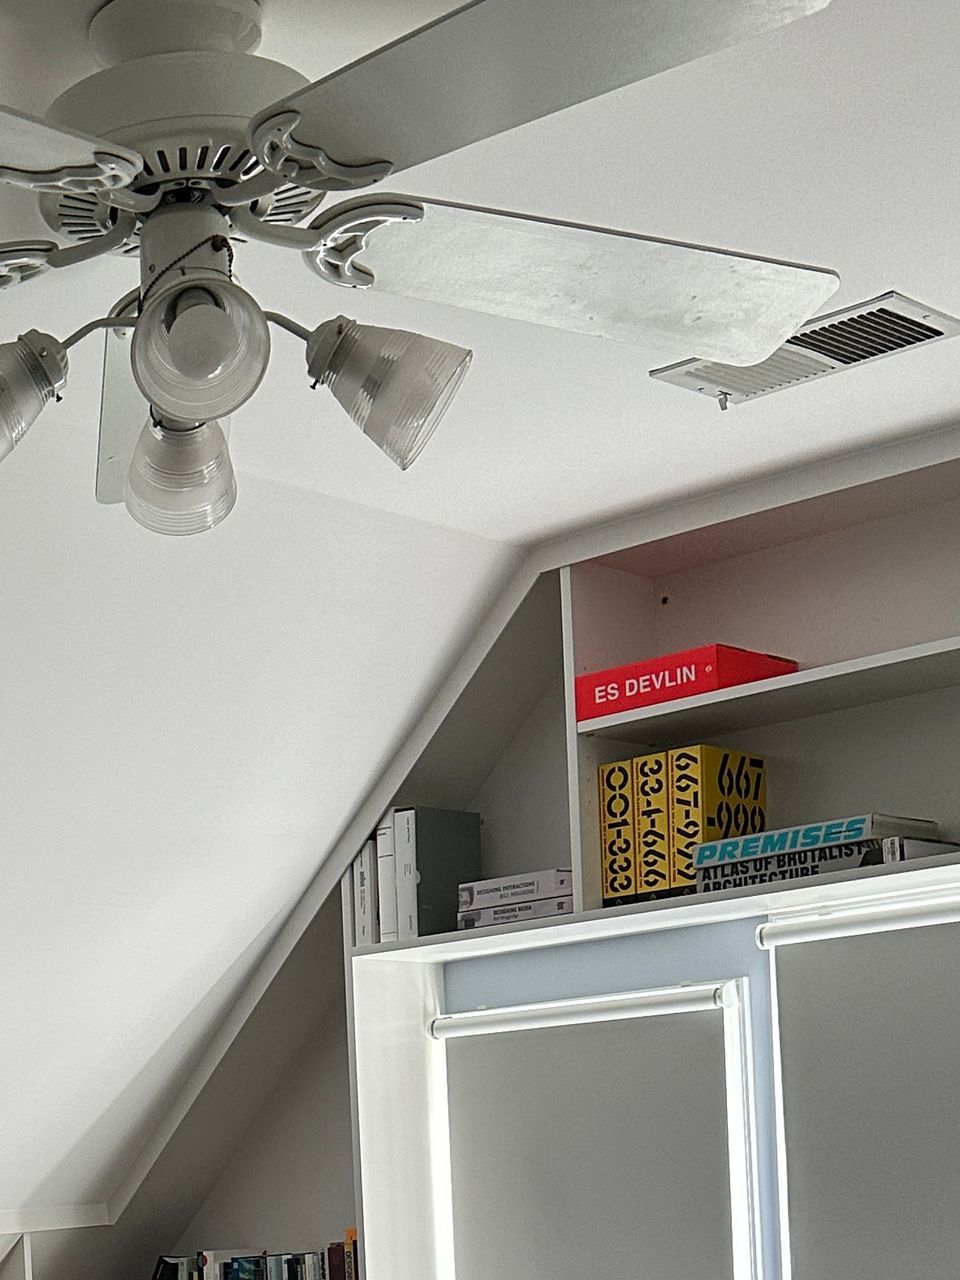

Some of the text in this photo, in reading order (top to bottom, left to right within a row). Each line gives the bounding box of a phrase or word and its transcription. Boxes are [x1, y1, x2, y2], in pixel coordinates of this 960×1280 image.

[594, 665, 696, 703] ES DEVLIN
[717, 753, 764, 800] 667
[695, 817, 869, 865] PREMISES
[702, 843, 864, 882] ATLAS OF BRUTALIST
[476, 881, 536, 896] DESIGNING INTERACTIONS
[493, 904, 532, 916] DESIGNING MEDIA
